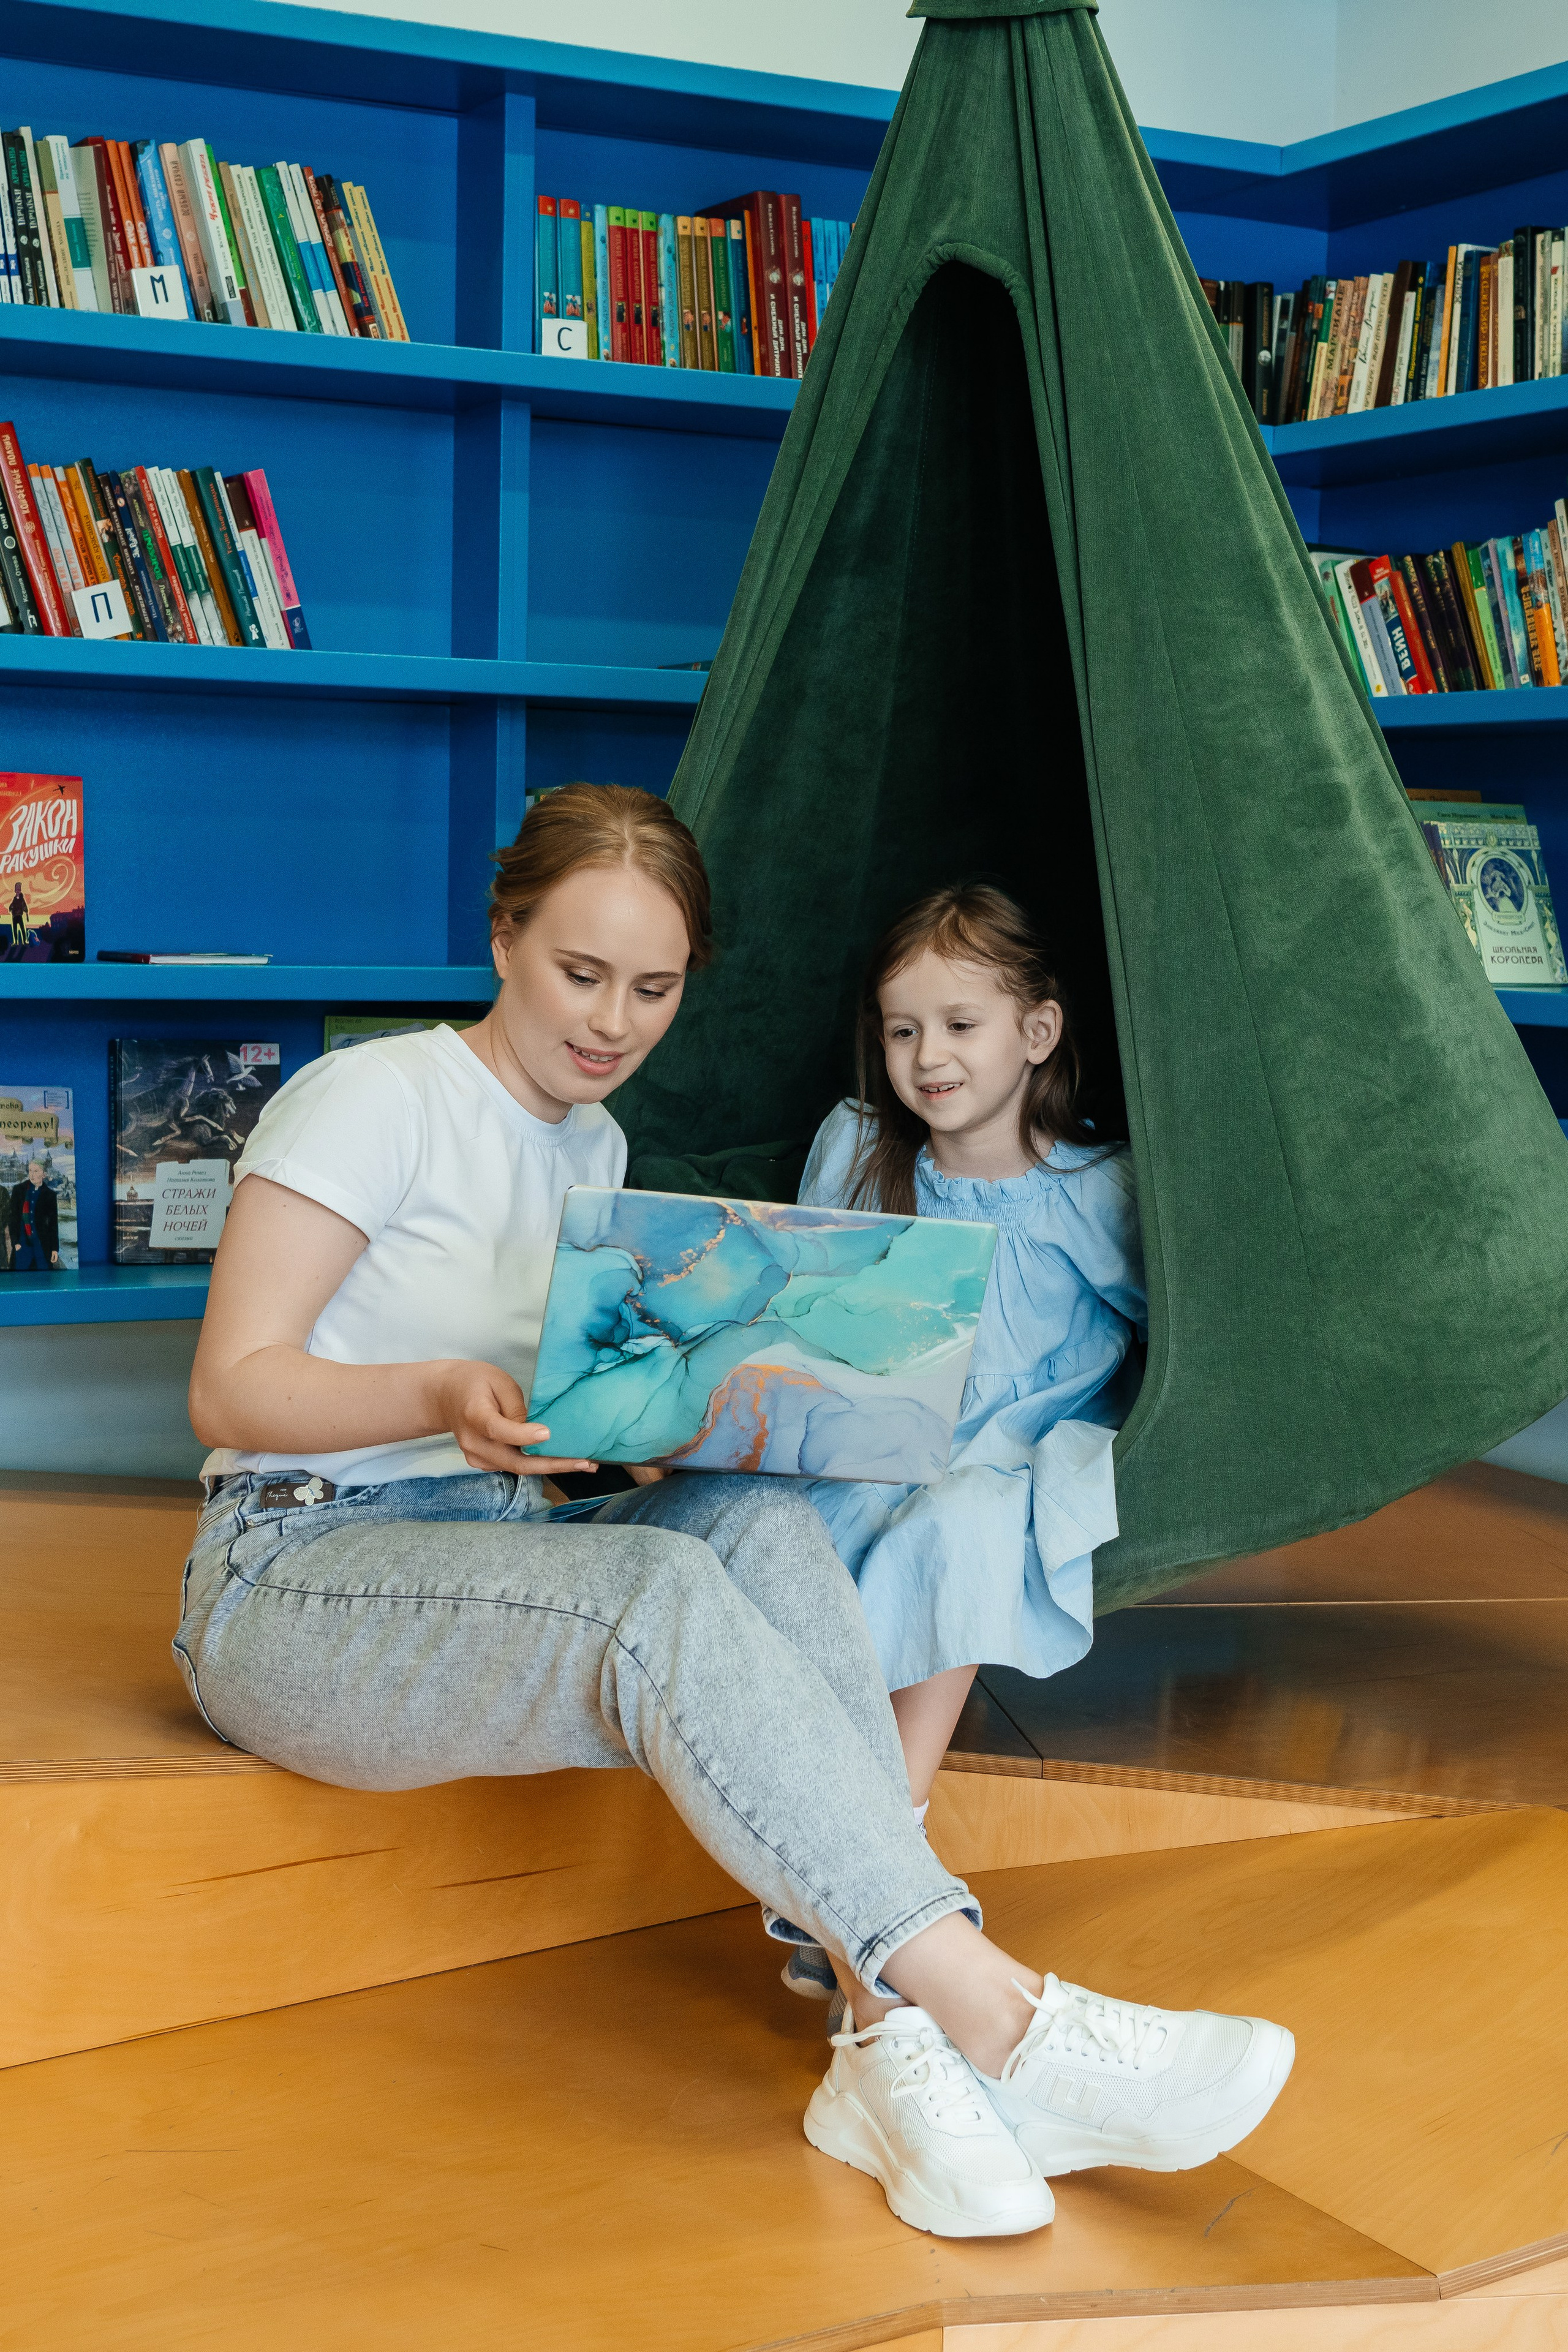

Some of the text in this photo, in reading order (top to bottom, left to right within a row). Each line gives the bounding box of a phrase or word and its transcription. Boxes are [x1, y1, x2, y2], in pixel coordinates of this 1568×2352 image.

[150, 274, 168, 304] М
[91, 592, 113, 623] П
[1389, 625, 1412, 671] ВЕЙН
[0, 799, 77, 854] ЗАКОН
[0, 837, 76, 874] РАКУШКИ
[1491, 956, 1544, 964] КОРОЛЕВА
[239, 1045, 276, 1062] 12+
[162, 1188, 216, 1199] СТРАЖИ
[165, 1204, 209, 1215] БЕЛЫХ
[163, 1218, 208, 1231] НОЧЕЙ
